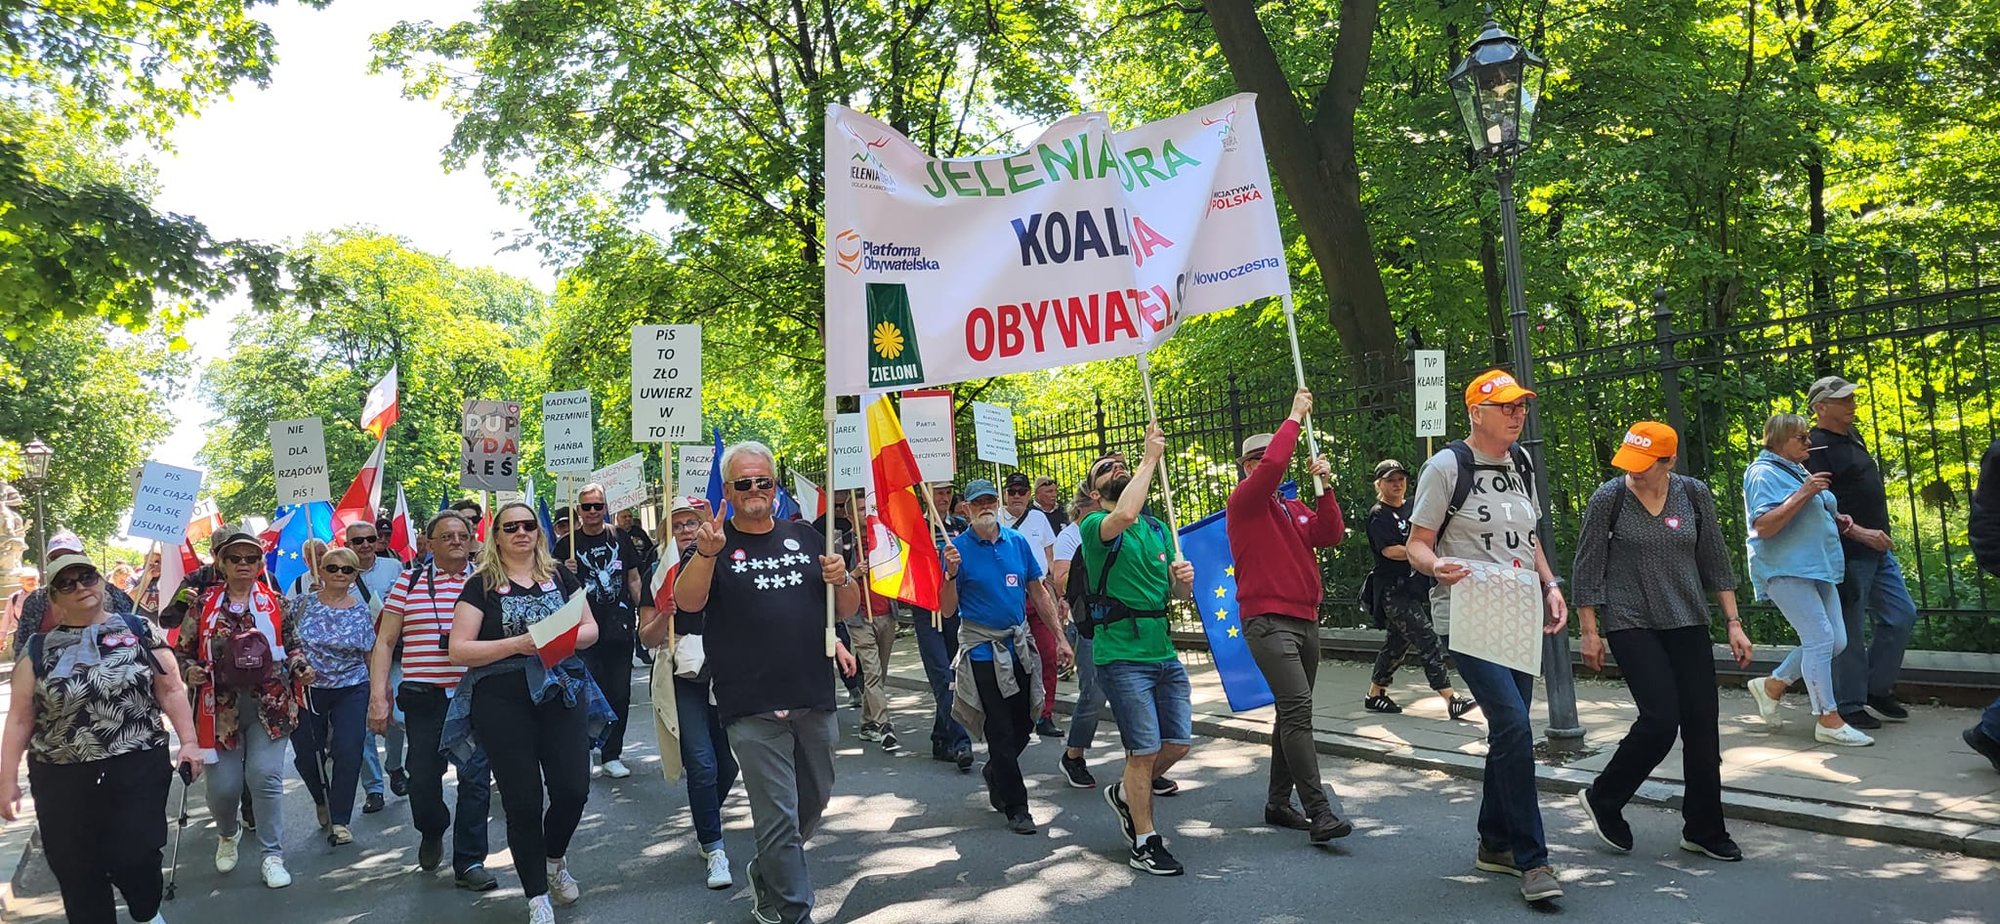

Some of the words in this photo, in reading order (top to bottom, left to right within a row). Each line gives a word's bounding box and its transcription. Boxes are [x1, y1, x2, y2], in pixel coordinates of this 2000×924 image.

[923, 133, 1121, 199] JELENIA
[1212, 190, 1263, 210] POLSKA
[863, 240, 921, 257] Platforma
[864, 257, 940, 273] Obywatelska
[1193, 256, 1279, 286] Nowoczesna
[655, 329, 676, 341] PiS
[657, 348, 675, 360] TO
[1424, 357, 1438, 368] TVP
[652, 368, 679, 379] ZŁO
[871, 363, 919, 383] ZIELONI
[1416, 376, 1444, 387] KŁAMIE
[640, 387, 694, 399] UWIERZ
[545, 396, 588, 407] KADENCJA
[1424, 400, 1438, 411] JAK
[545, 411, 589, 422] PRZEMINIE
[659, 407, 674, 418] W
[466, 413, 519, 433] DUP
[1420, 419, 1432, 430] PiS
[287, 424, 305, 435] NIE
[648, 426, 666, 438] TO
[835, 426, 857, 434] JAREK
[288, 446, 309, 456] DLA
[554, 440, 583, 451] HAŃBA
[466, 457, 513, 476] ŁEŚ
[550, 457, 590, 467] ZOSTANIE
[164, 471, 182, 482] PiS
[278, 465, 324, 479] RZĄDÓW
[840, 468, 851, 476] SIĘ
[141, 485, 160, 495] NIE
[162, 489, 194, 502] CIĄŻA
[292, 488, 308, 498] PiS
[146, 503, 162, 513] DA
[164, 508, 182, 519] SIĘ
[132, 519, 180, 535] USUNĄĆ
